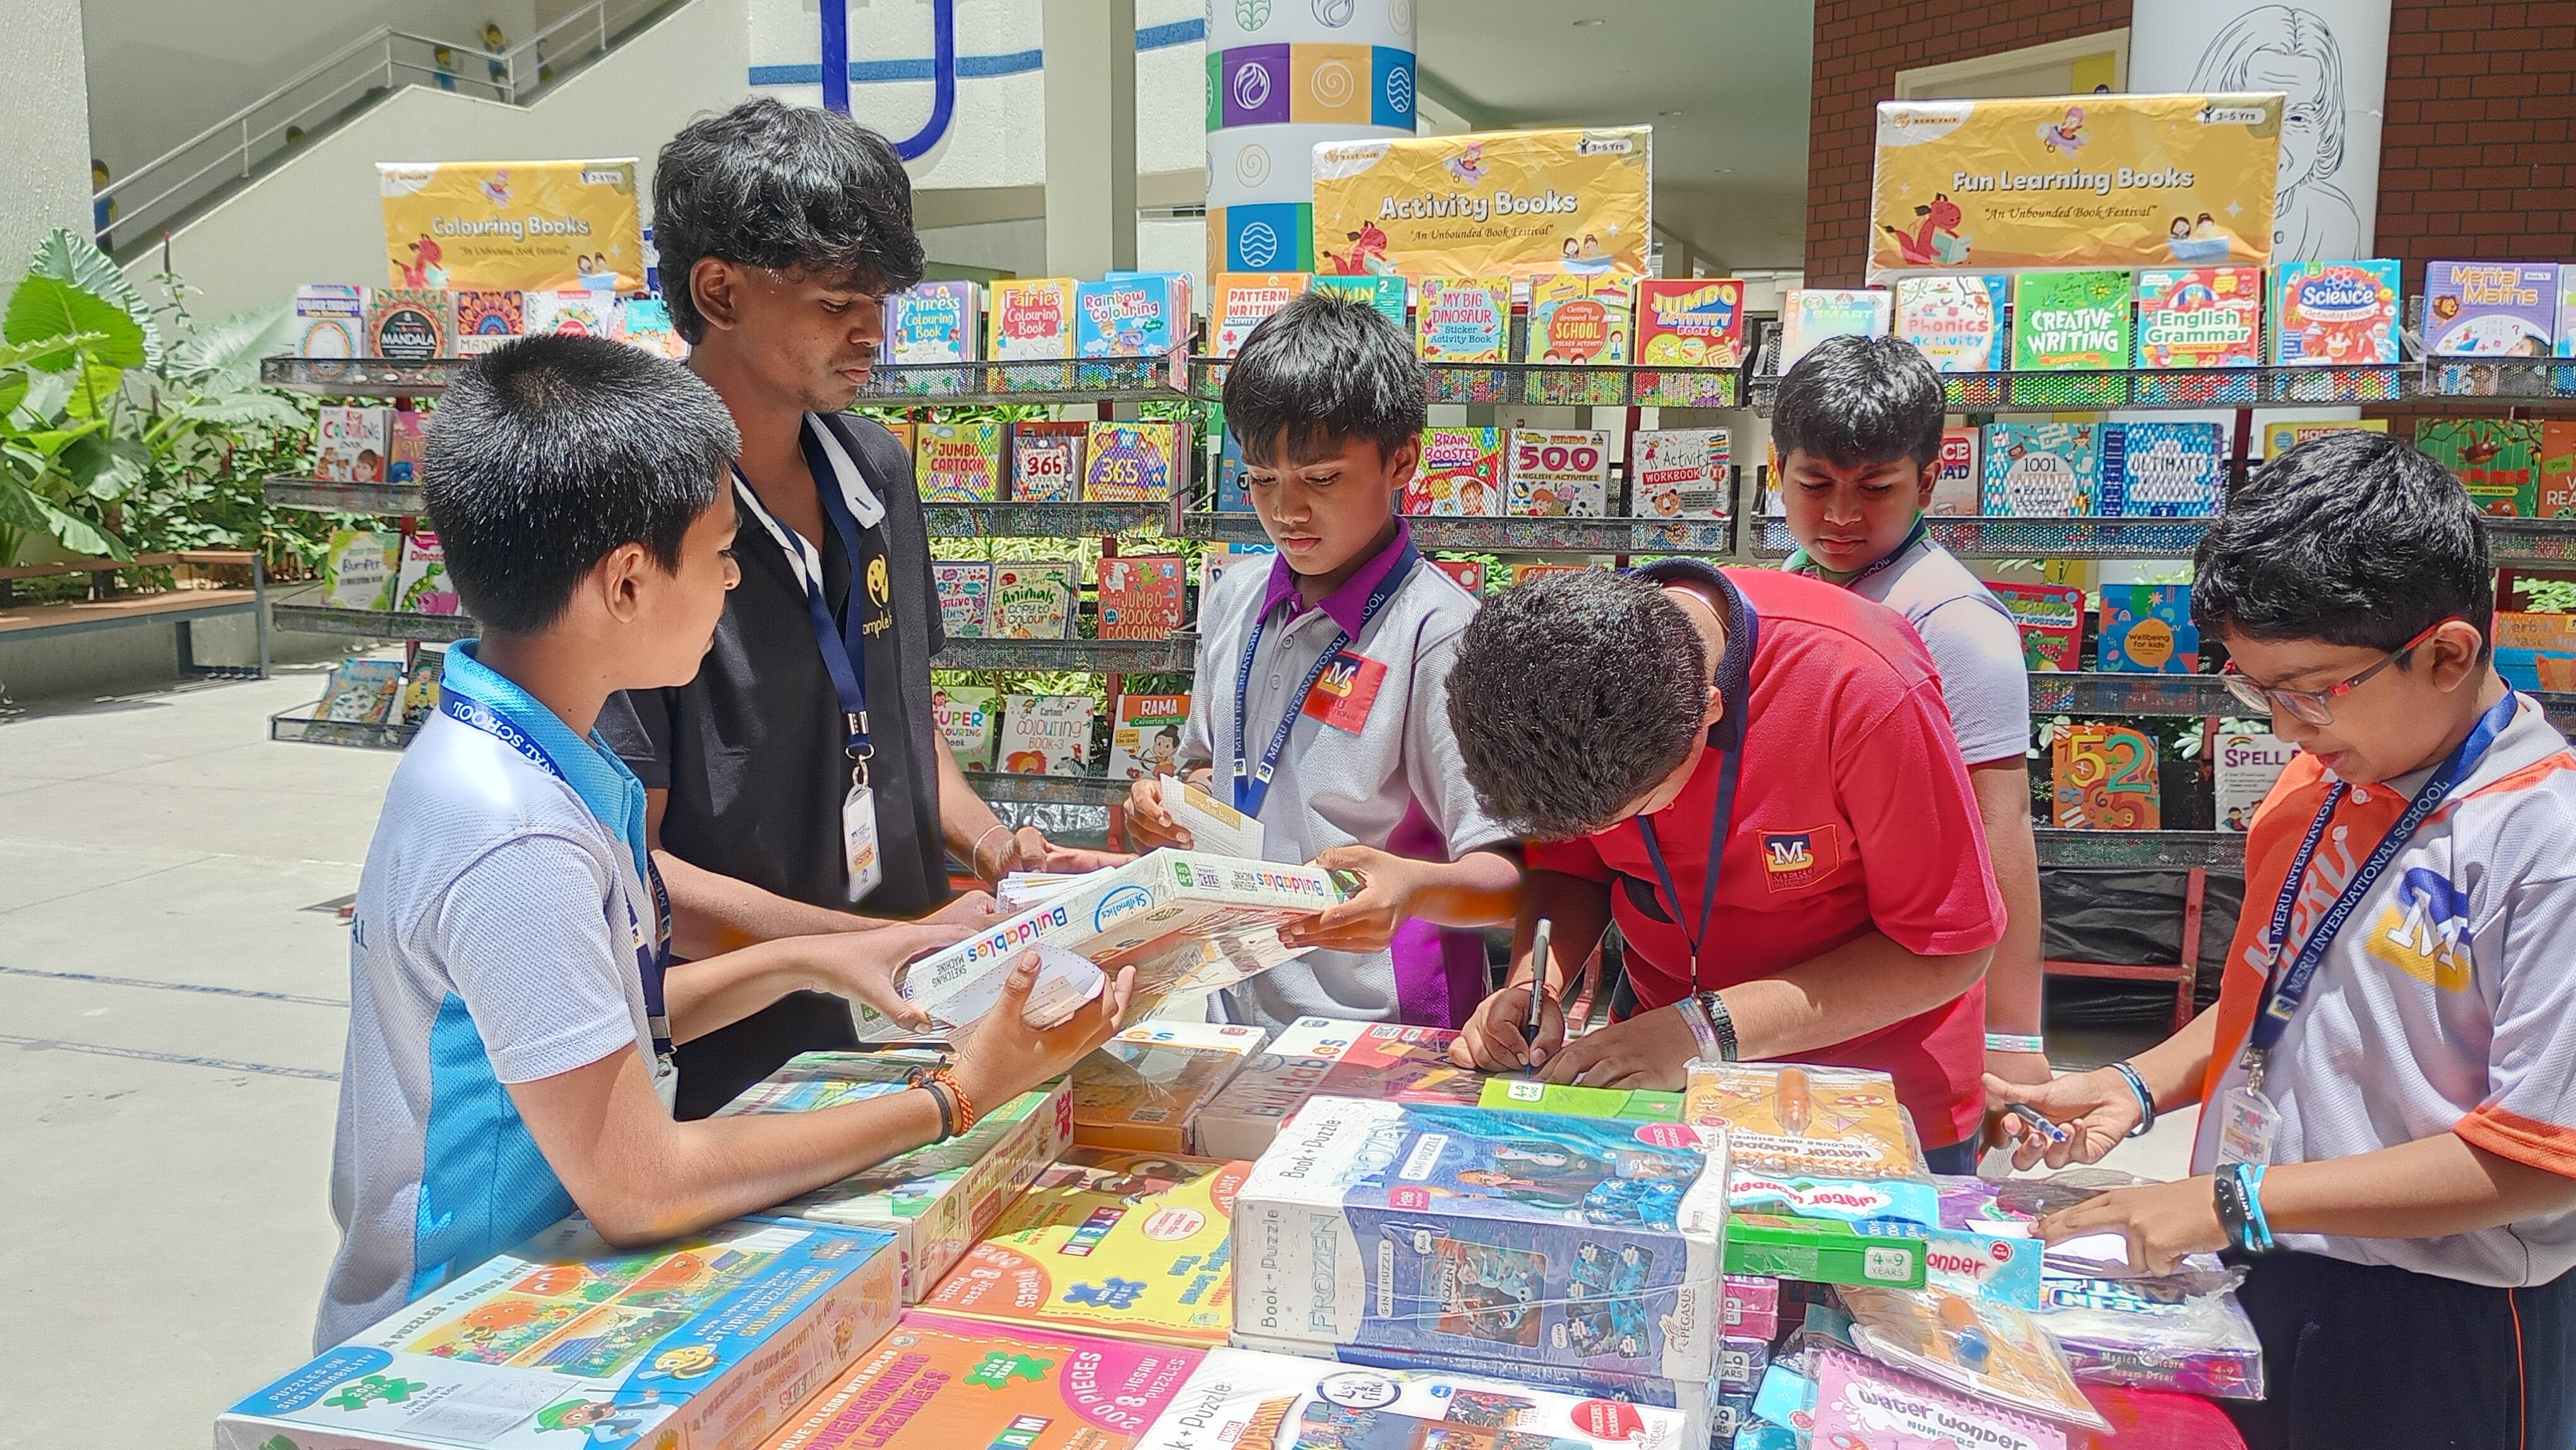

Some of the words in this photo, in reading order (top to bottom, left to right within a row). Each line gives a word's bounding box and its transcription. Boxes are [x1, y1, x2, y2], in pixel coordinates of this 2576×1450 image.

[1952, 171, 1995, 192] Fun
[2000, 167, 2111, 195] Learning
[2117, 166, 2194, 189] Books
[1379, 192, 1489, 222] Activity
[1495, 189, 1578, 215] Books
[2008, 207, 2070, 219] Unbounded
[2073, 206, 2102, 218] Book
[432, 215, 523, 243] Colouring
[529, 215, 591, 237] Books
[1431, 226, 1482, 241] Unbounded
[1484, 226, 1510, 239] Book
[1379, 280, 1388, 292] 2
[2451, 265, 2519, 287] Mental
[898, 294, 960, 313] Princess
[1004, 289, 1061, 309] Fairies
[1083, 290, 1146, 311] Rainbow
[1230, 289, 1287, 303] PATTERN
[1443, 292, 1461, 307] MY
[1462, 292, 1482, 306] BIG
[1652, 284, 1738, 314] JUMBO
[2302, 286, 2376, 308] Science
[2464, 283, 2539, 306] Maths
[1008, 309, 1058, 324] Colouring
[1090, 302, 1160, 322] Colouring
[1432, 308, 1492, 324] DINOSAUR
[1559, 313, 1587, 323] dressed
[1588, 313, 1600, 322] for
[1566, 304, 1594, 316] Getting
[1658, 311, 1731, 327] ACTIVITY
[1812, 308, 1873, 320] SMART
[2030, 308, 2114, 330] CREATIVE
[905, 313, 954, 328] Colouring
[1018, 322, 1047, 335] Book
[1224, 318, 1260, 327] ACTIVITY
[1445, 325, 1477, 335] Sticker
[1554, 321, 1602, 340] SCHOOL
[1909, 318, 1989, 333] Phonics
[2159, 309, 2238, 332] English
[381, 333, 437, 346] MANDALA
[915, 327, 943, 340] Book
[1431, 335, 1467, 346] Activity
[1469, 334, 1492, 344] Book
[1677, 326, 1709, 336] BOOK
[1713, 327, 1722, 337] 2
[2145, 327, 2251, 345] Grammar
[1912, 335, 1984, 349] Activity
[2026, 330, 2119, 354] WRITING
[1434, 432, 1472, 447] BRAIN
[1548, 434, 1587, 445] JUMBO
[1424, 446, 1480, 461] BOOSTER
[1520, 446, 1599, 472] 500
[1663, 449, 1710, 477] Activity
[1027, 456, 1062, 476] 365
[1100, 457, 1140, 484] 365
[2024, 457, 2058, 473] 1001
[1553, 473, 1599, 481] ACTIVITIES
[1645, 468, 1700, 484] WORKBOOK
[1021, 577, 1033, 585] My
[1002, 586, 1056, 606] Animals
[1121, 592, 1163, 608] JUMBO
[1037, 604, 1050, 614] to
[1119, 608, 1152, 625] BOOK
[2027, 617, 2073, 627] WORKBOOK
[2128, 632, 2170, 643] Wellbeing
[2133, 640, 2145, 649] for
[2147, 640, 2165, 649] kids
[1323, 661, 1357, 690] M
[1140, 697, 1178, 717] RAMA
[1268, 722, 1289, 760] MERU
[1284, 634, 1347, 726] INTERNATIONAL
[1039, 707, 1063, 717] Cartoon
[1134, 717, 1167, 727] Colouring
[453, 700, 524, 750] SCHOOL
[2071, 734, 2152, 793] 52
[2224, 748, 2286, 767] SPELL
[854, 847, 872, 867] VISITOR
[1771, 841, 1806, 865] M
[1772, 866, 1815, 881] MERU
[1256, 871, 1325, 897] Buildables
[2286, 956, 2315, 995] MERU
[2313, 840, 2400, 956] INTERNATIONAL
[2394, 778, 2450, 840] SCHOOL
[2272, 889, 2293, 937] MERU
[967, 906, 1069, 963] Buildables
[935, 954, 965, 975] MACHINE
[932, 964, 967, 988] SKETCHING
[1279, 1157, 1318, 1180] Book
[1301, 1116, 1342, 1149] Puzzle
[1260, 1209, 1279, 1271] Puzzle
[970, 1245, 1025, 1268] 200
[1381, 1243, 1391, 1285] PUZZLE
[1872, 1253, 1905, 1266] 4-9
[1308, 1213, 1340, 1335] FROZEN
[1871, 1266, 1905, 1277] YEARS
[1261, 1286, 1278, 1329] Book
[1679, 1287, 1691, 1339] PEGASUS
[390, 1305, 448, 1341] PUZZLES
[268, 1365, 328, 1402] PUZZLES
[329, 1357, 347, 1370] ON
[275, 1353, 377, 1410] SUSTAINABILITY
[1070, 1351, 1104, 1405] PIECES
[1121, 1355, 1160, 1394] JIGSAW
[1144, 1357, 1186, 1399] PUZZLES
[347, 1383, 377, 1399] 200
[803, 1417, 824, 1429] TO
[816, 1393, 851, 1422] LEARN
[842, 1372, 873, 1393] WITH
[862, 1349, 899, 1375] BIPLOB
[852, 1368, 951, 1449] LAZINESS
[1179, 1381, 1232, 1429] Puzzle
[1858, 1388, 1934, 1420] water
[1090, 1403, 1145, 1430] 200
[1217, 1420, 1246, 1442] MARVEL
